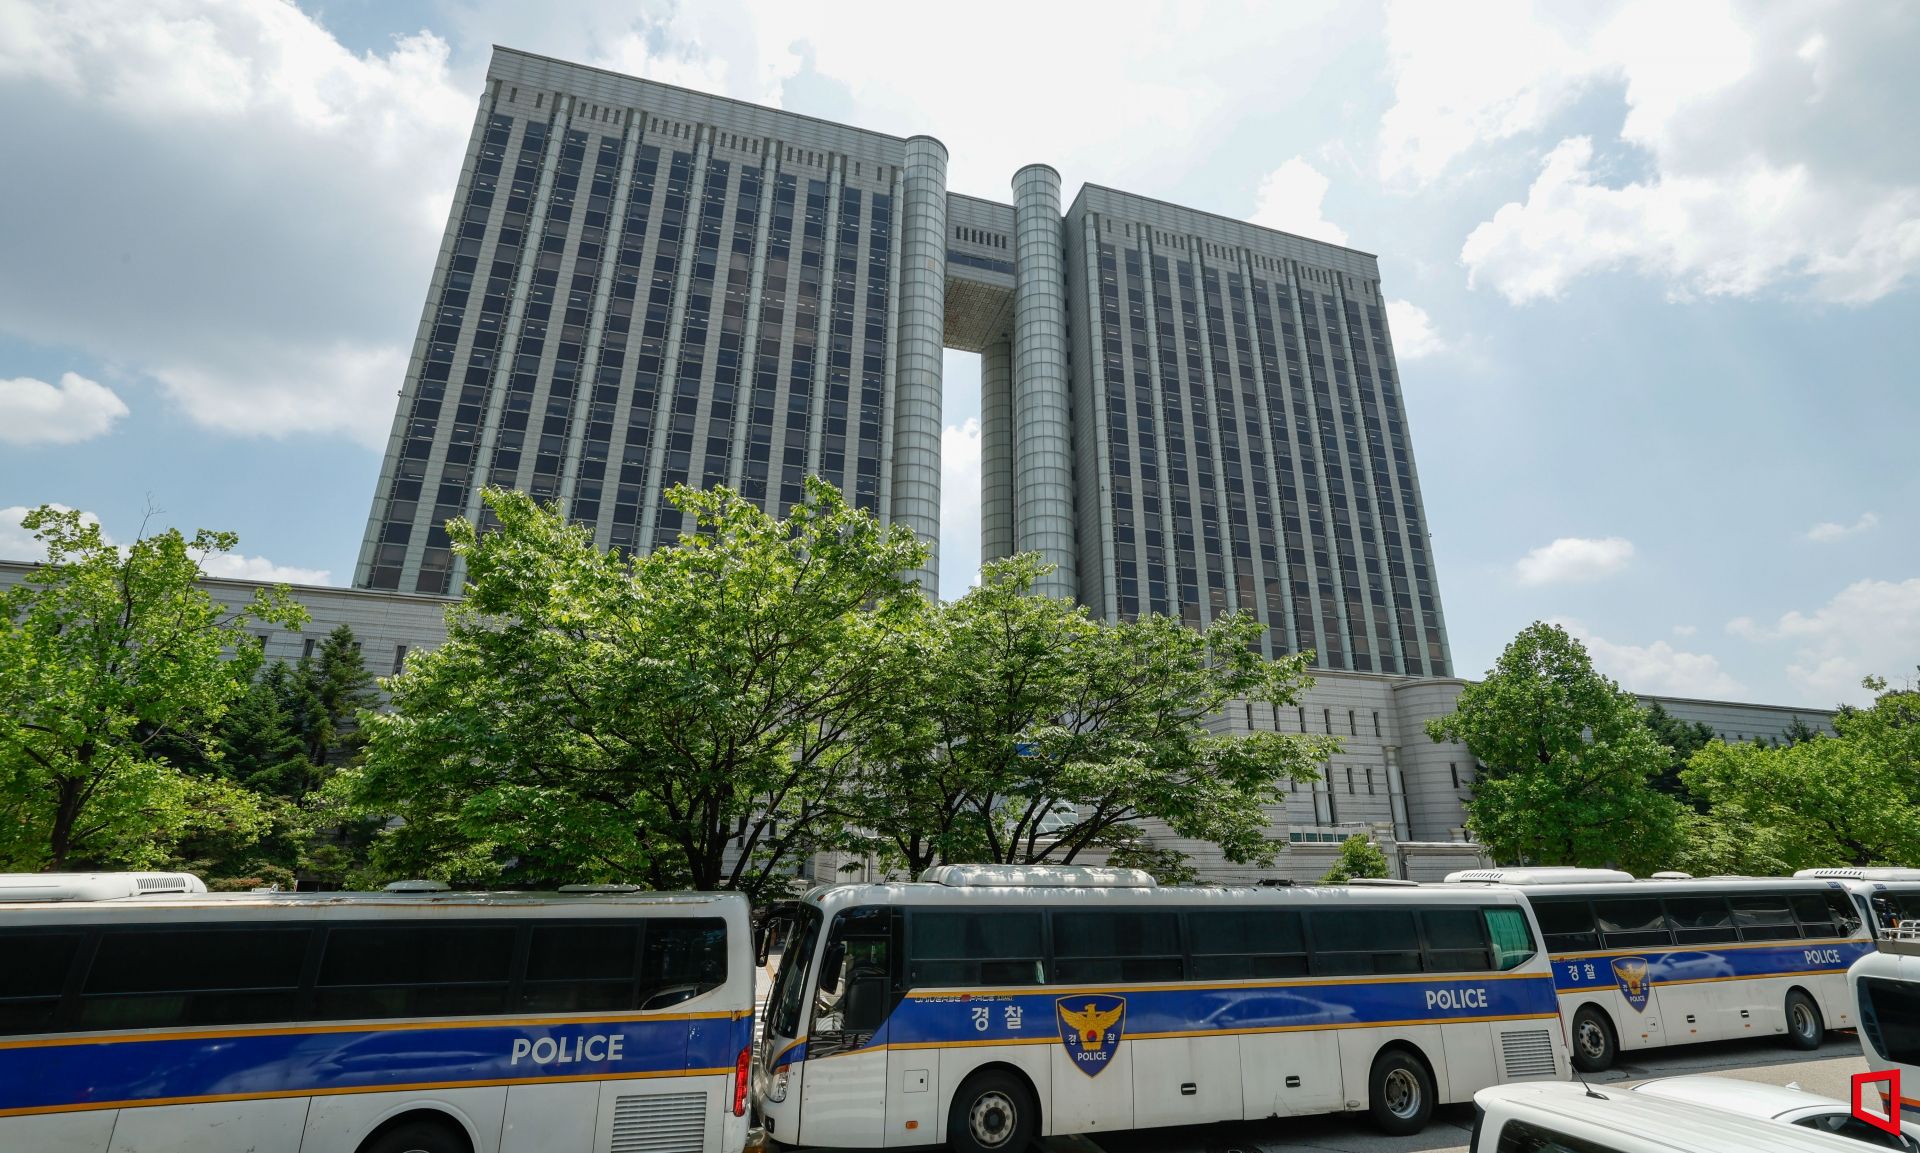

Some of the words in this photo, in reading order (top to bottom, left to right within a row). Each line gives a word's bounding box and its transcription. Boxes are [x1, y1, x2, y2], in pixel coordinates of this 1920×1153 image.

[1804, 949, 1841, 964] POLICE
[1425, 988, 1488, 1009] POLICE
[510, 1034, 624, 1065] POLICE
[1077, 1051, 1107, 1061] POLICE
